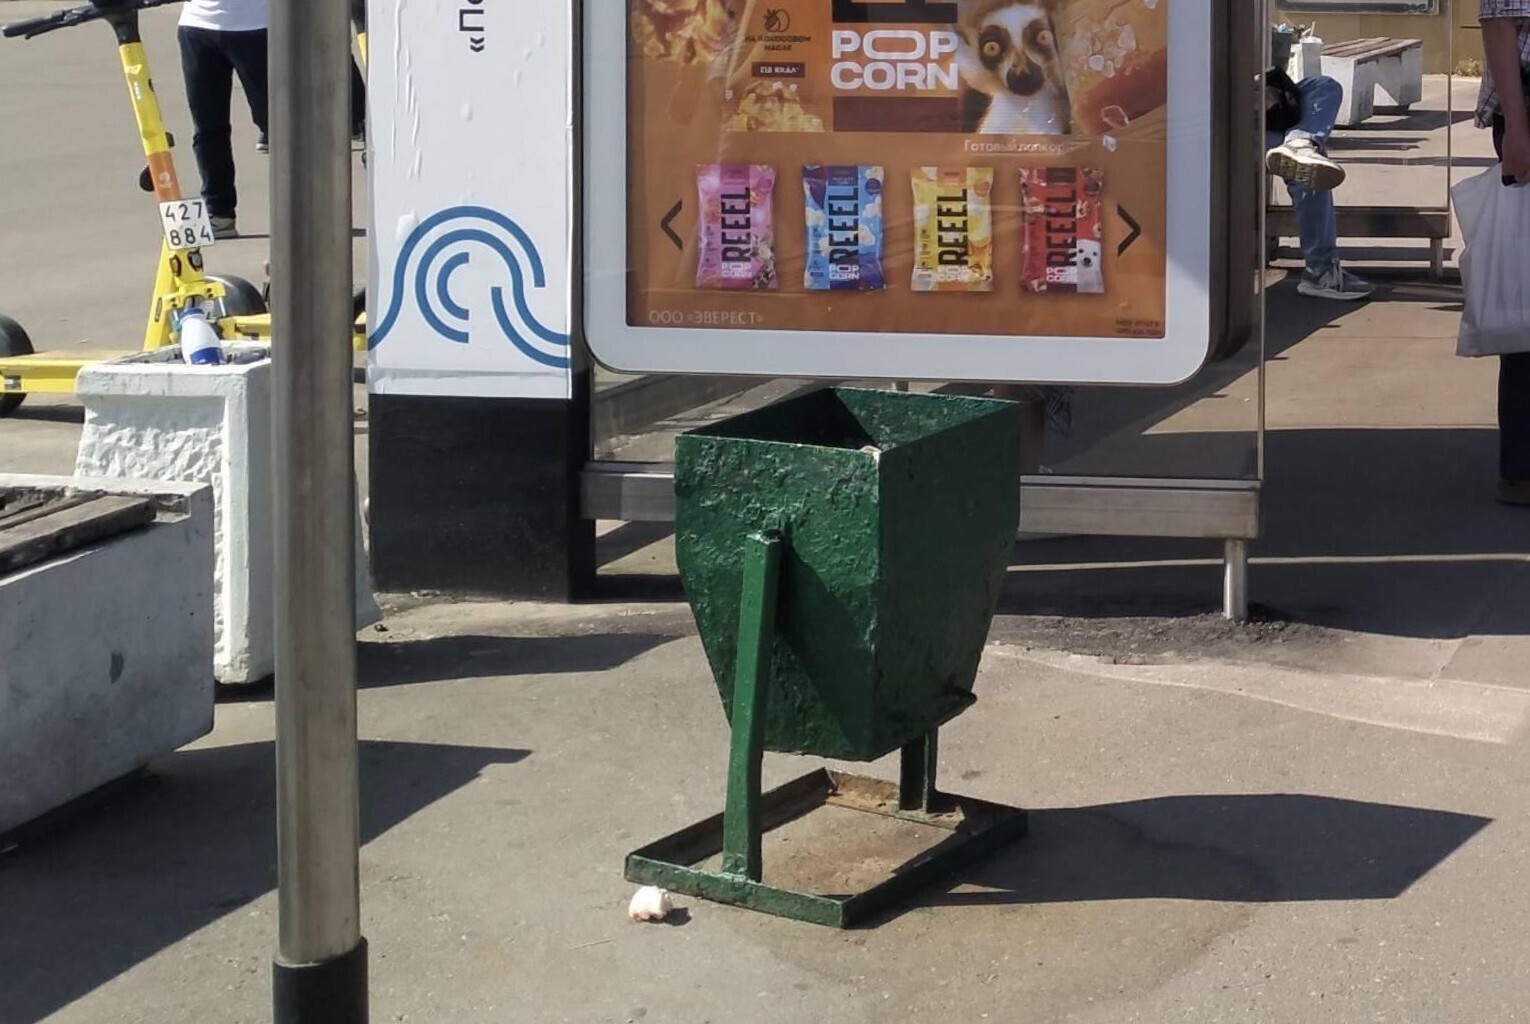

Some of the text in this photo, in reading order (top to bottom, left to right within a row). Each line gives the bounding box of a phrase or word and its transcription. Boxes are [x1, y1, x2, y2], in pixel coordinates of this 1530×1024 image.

[831, 29, 958, 60] POP
[830, 61, 959, 91] CORN
[165, 202, 203, 222] 427
[721, 186, 751, 262] REEEL
[828, 187, 859, 264] REEEL
[937, 188, 968, 265] REEEL
[169, 225, 211, 246] 884
[829, 264, 859, 273] POP
[648, 310, 683, 324] ООО
